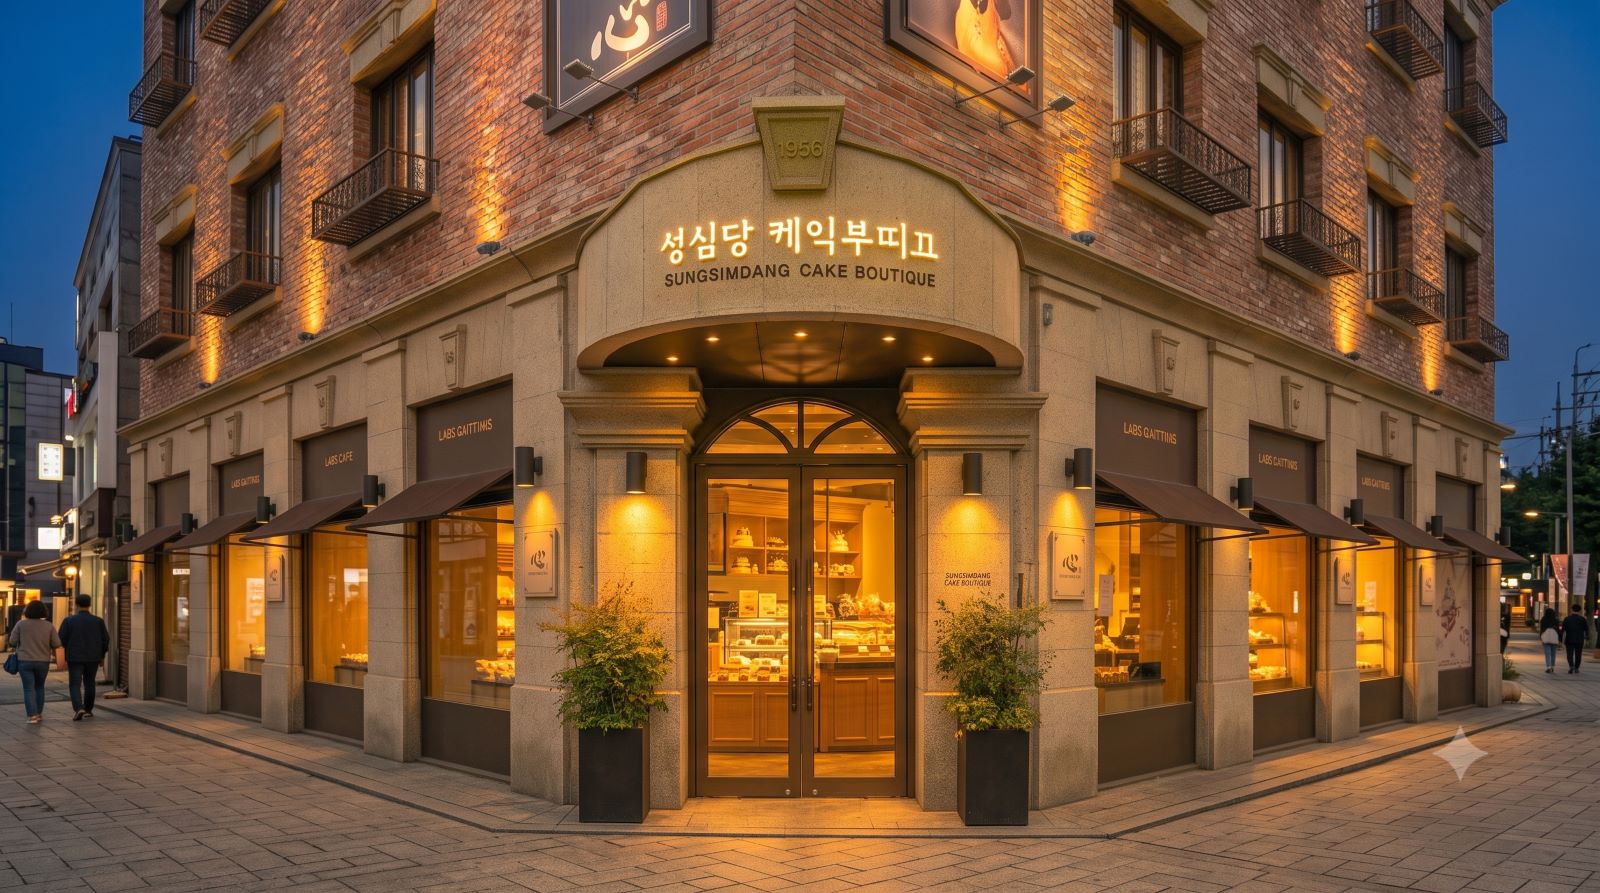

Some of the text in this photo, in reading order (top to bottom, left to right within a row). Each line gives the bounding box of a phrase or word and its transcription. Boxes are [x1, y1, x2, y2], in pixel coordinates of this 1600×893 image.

[778, 140, 823, 159] 1956
[660, 218, 755, 265] 성심당
[664, 263, 936, 288] SUNGSIMDANG CAKE BOUTIQUE
[438, 427, 456, 442] LABS
[1123, 421, 1142, 438] LABS
[338, 450, 353, 464] CAFE
[944, 579, 992, 587] CAKE BOUTIQUE
